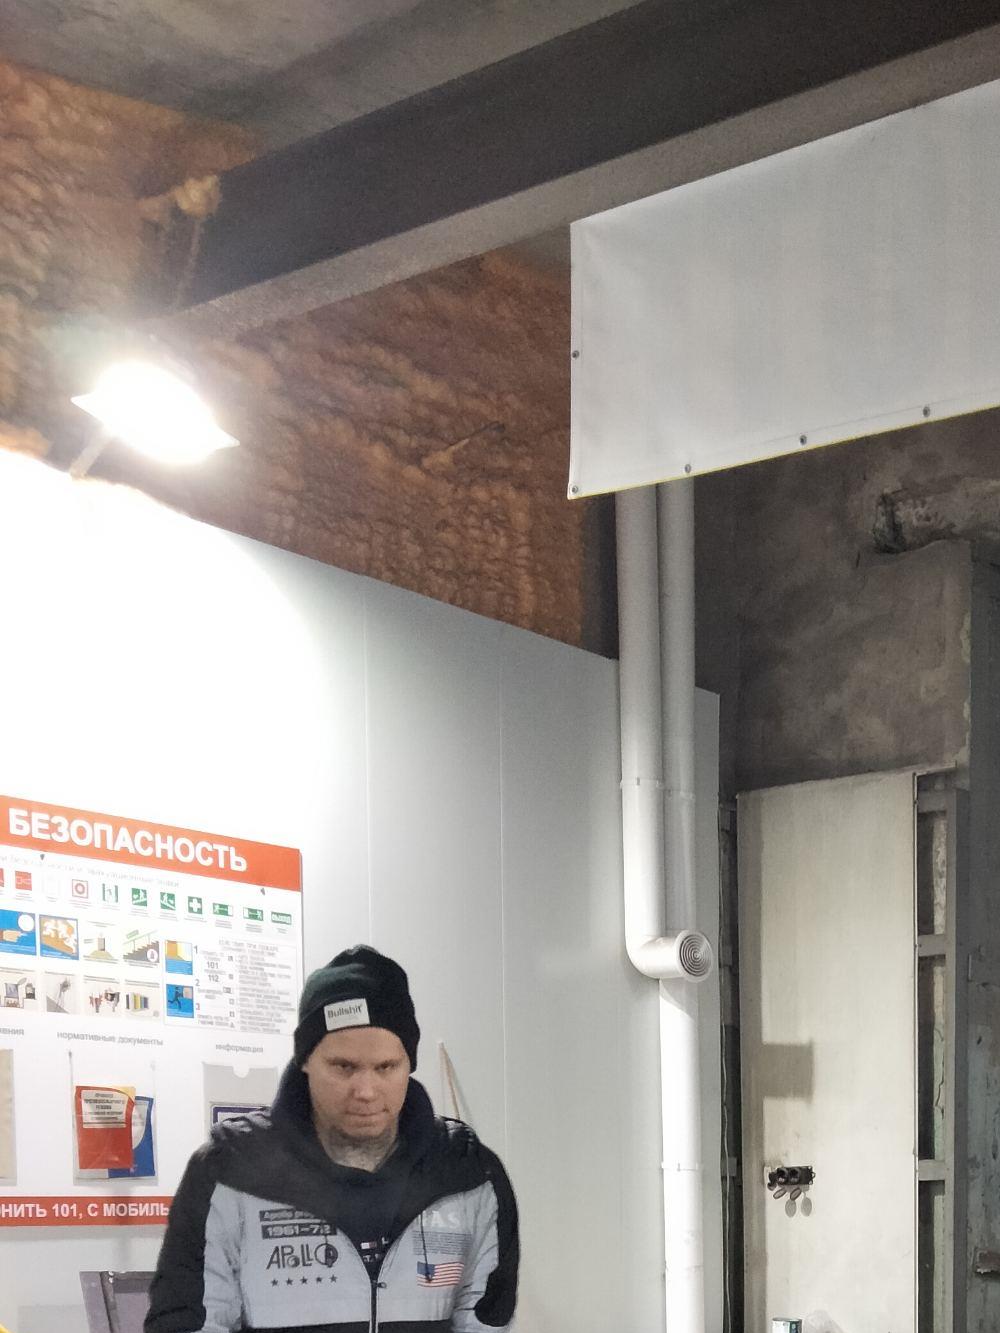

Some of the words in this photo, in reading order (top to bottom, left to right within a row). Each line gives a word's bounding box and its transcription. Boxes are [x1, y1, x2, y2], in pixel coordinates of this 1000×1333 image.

[8, 806, 248, 873] БЕЗОПАСНОСТЬ
[57, 1031, 116, 1043] нормативные
[118, 1035, 164, 1046] документы
[0, 1203, 47, 1218] НИТЬ
[52, 1203, 83, 1219] 101,
[87, 1203, 98, 1217] С
